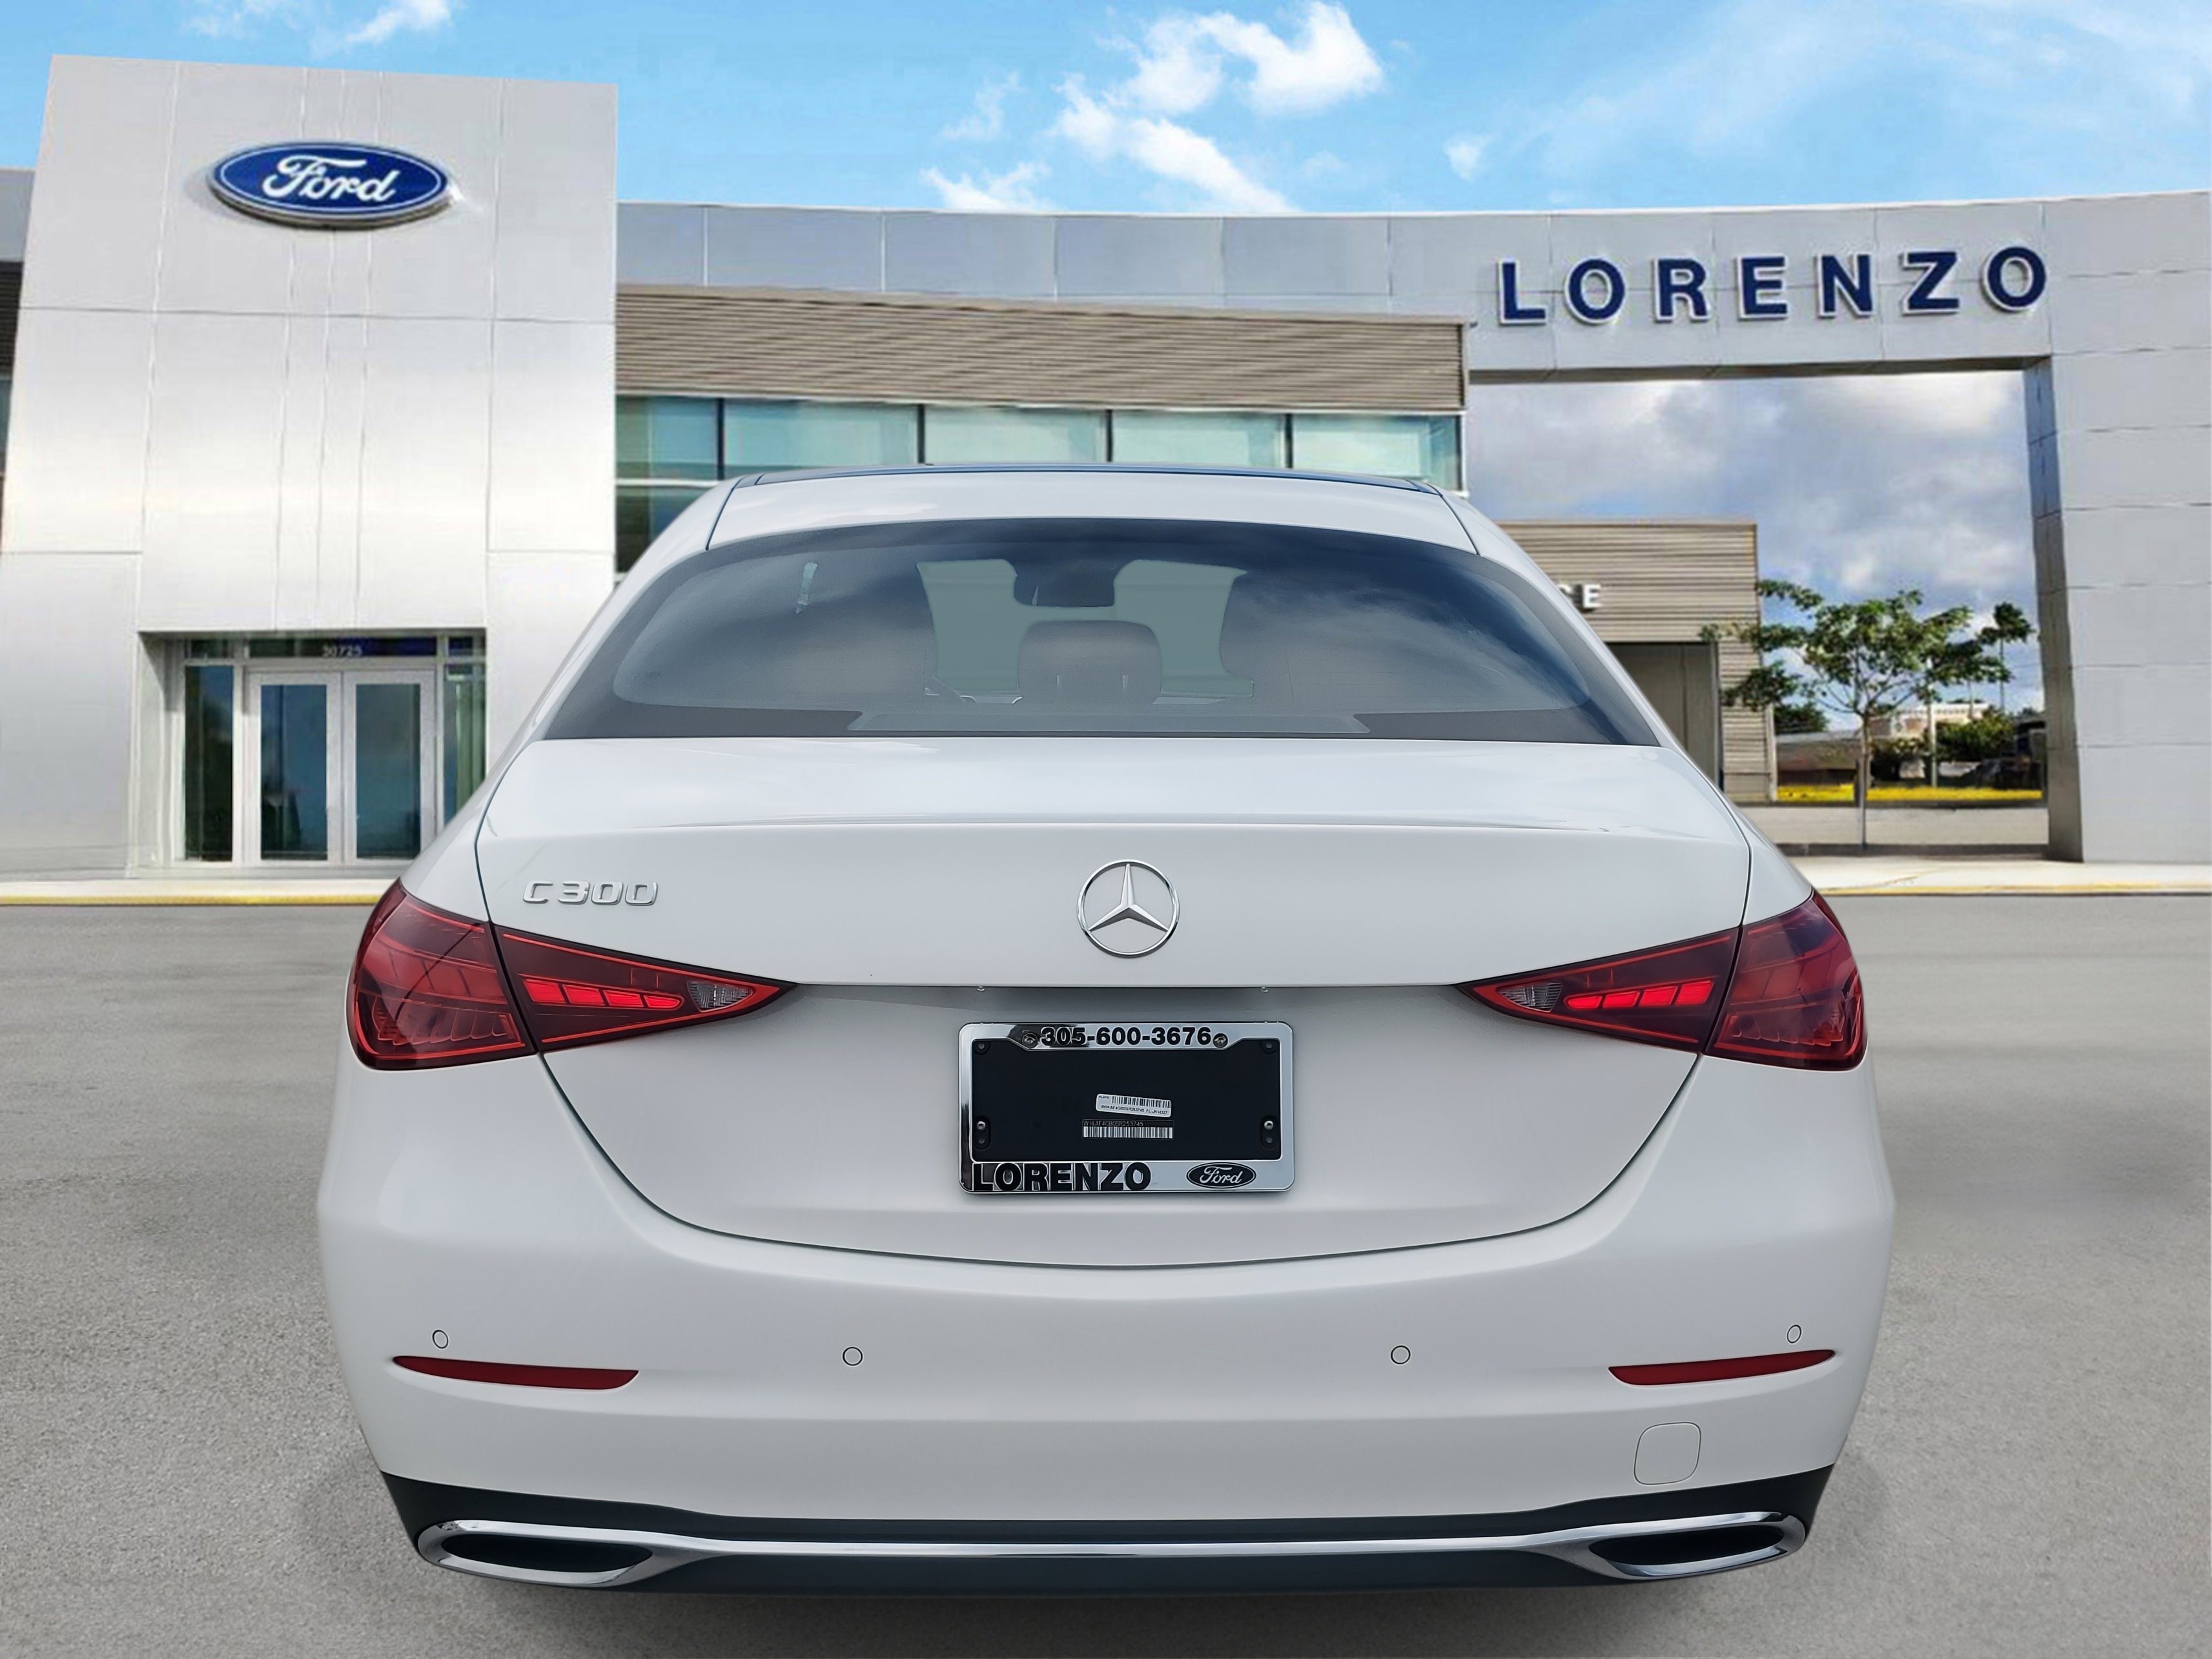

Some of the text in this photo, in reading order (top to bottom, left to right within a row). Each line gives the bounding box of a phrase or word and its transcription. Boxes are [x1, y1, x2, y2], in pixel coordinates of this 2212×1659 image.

[262, 154, 400, 202] Ford
[1497, 246, 2047, 325] LORENZO
[523, 880, 659, 906] C 300
[1040, 1027, 1211, 1046] 305-600-3676
[972, 1162, 1152, 1191] LORENZO
[1199, 1166, 1242, 1184] Ford
